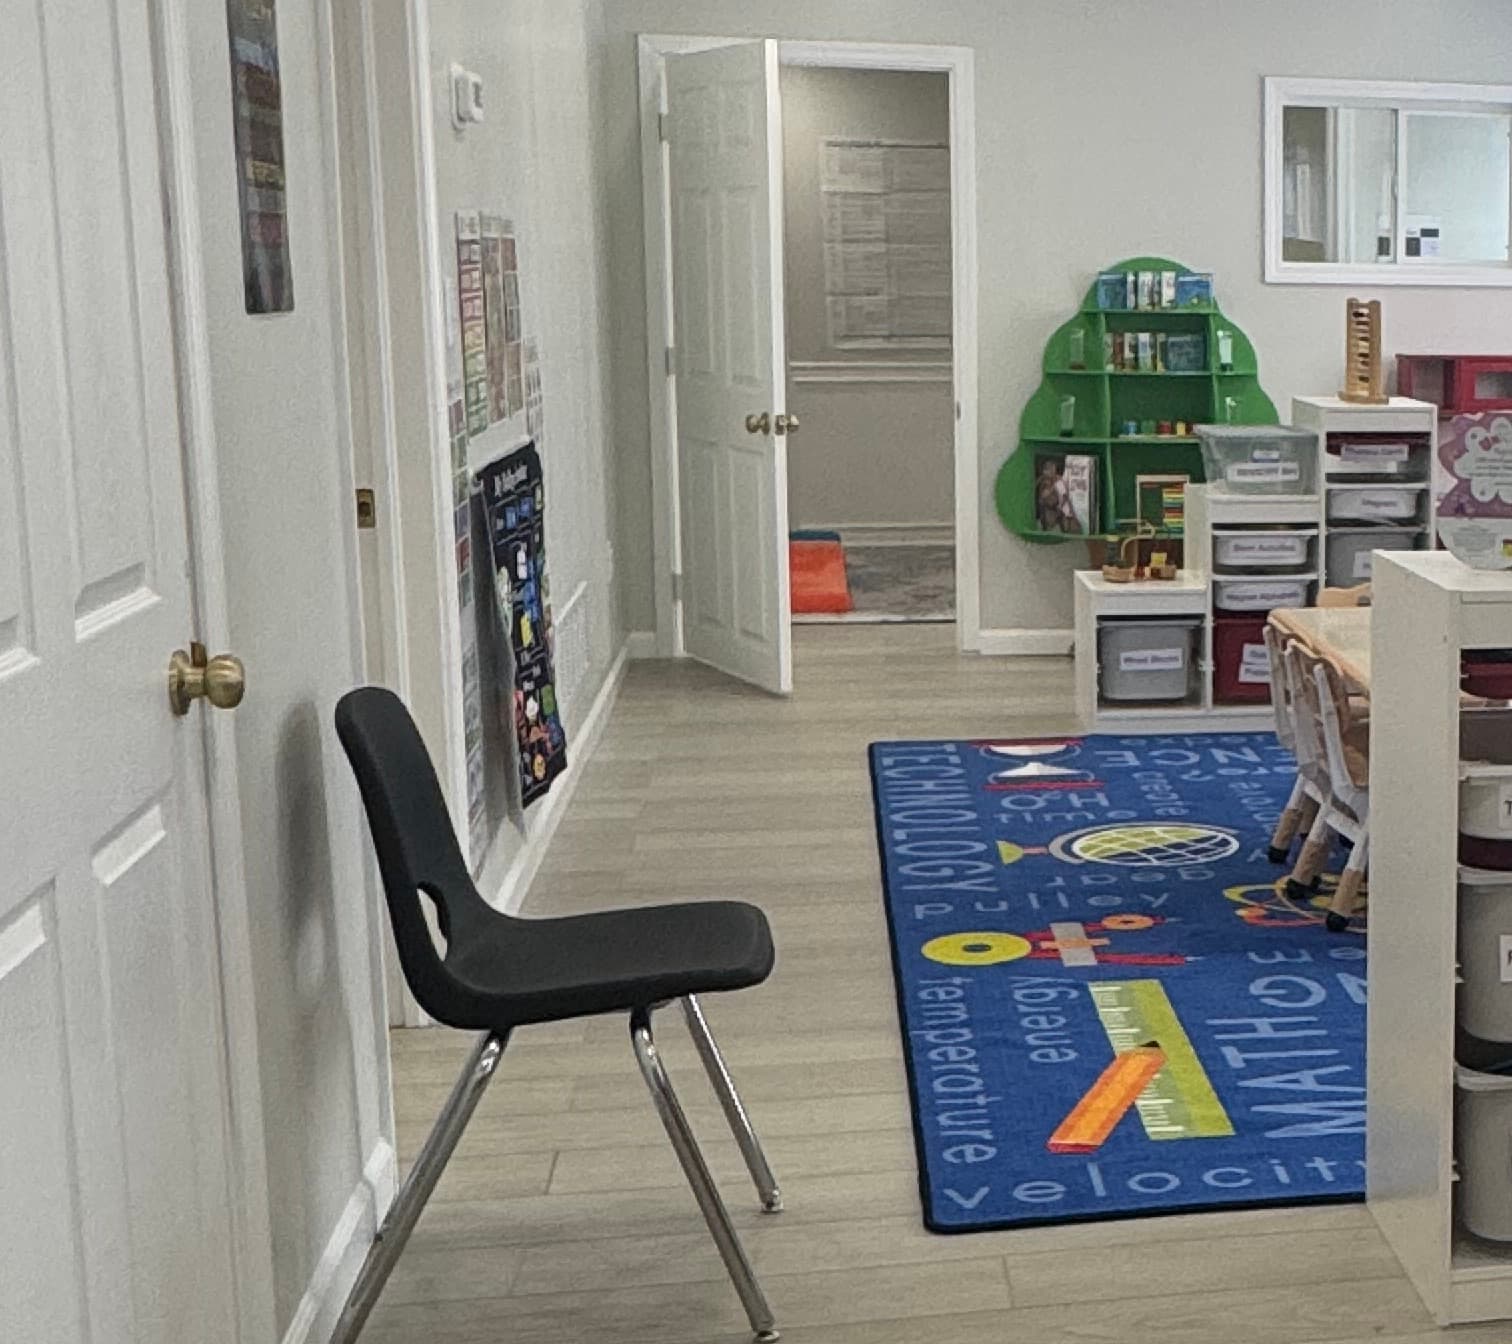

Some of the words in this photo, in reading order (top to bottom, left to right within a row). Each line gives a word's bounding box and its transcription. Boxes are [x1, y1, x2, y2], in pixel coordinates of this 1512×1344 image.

[881, 743, 999, 891] TECHNOLOGY
[914, 891, 1170, 919] pulley
[910, 977, 1002, 1164] temperature
[1008, 976, 1080, 1064] energy
[1205, 1016, 1367, 1138] MATH
[943, 1156, 1367, 1209] velocit
